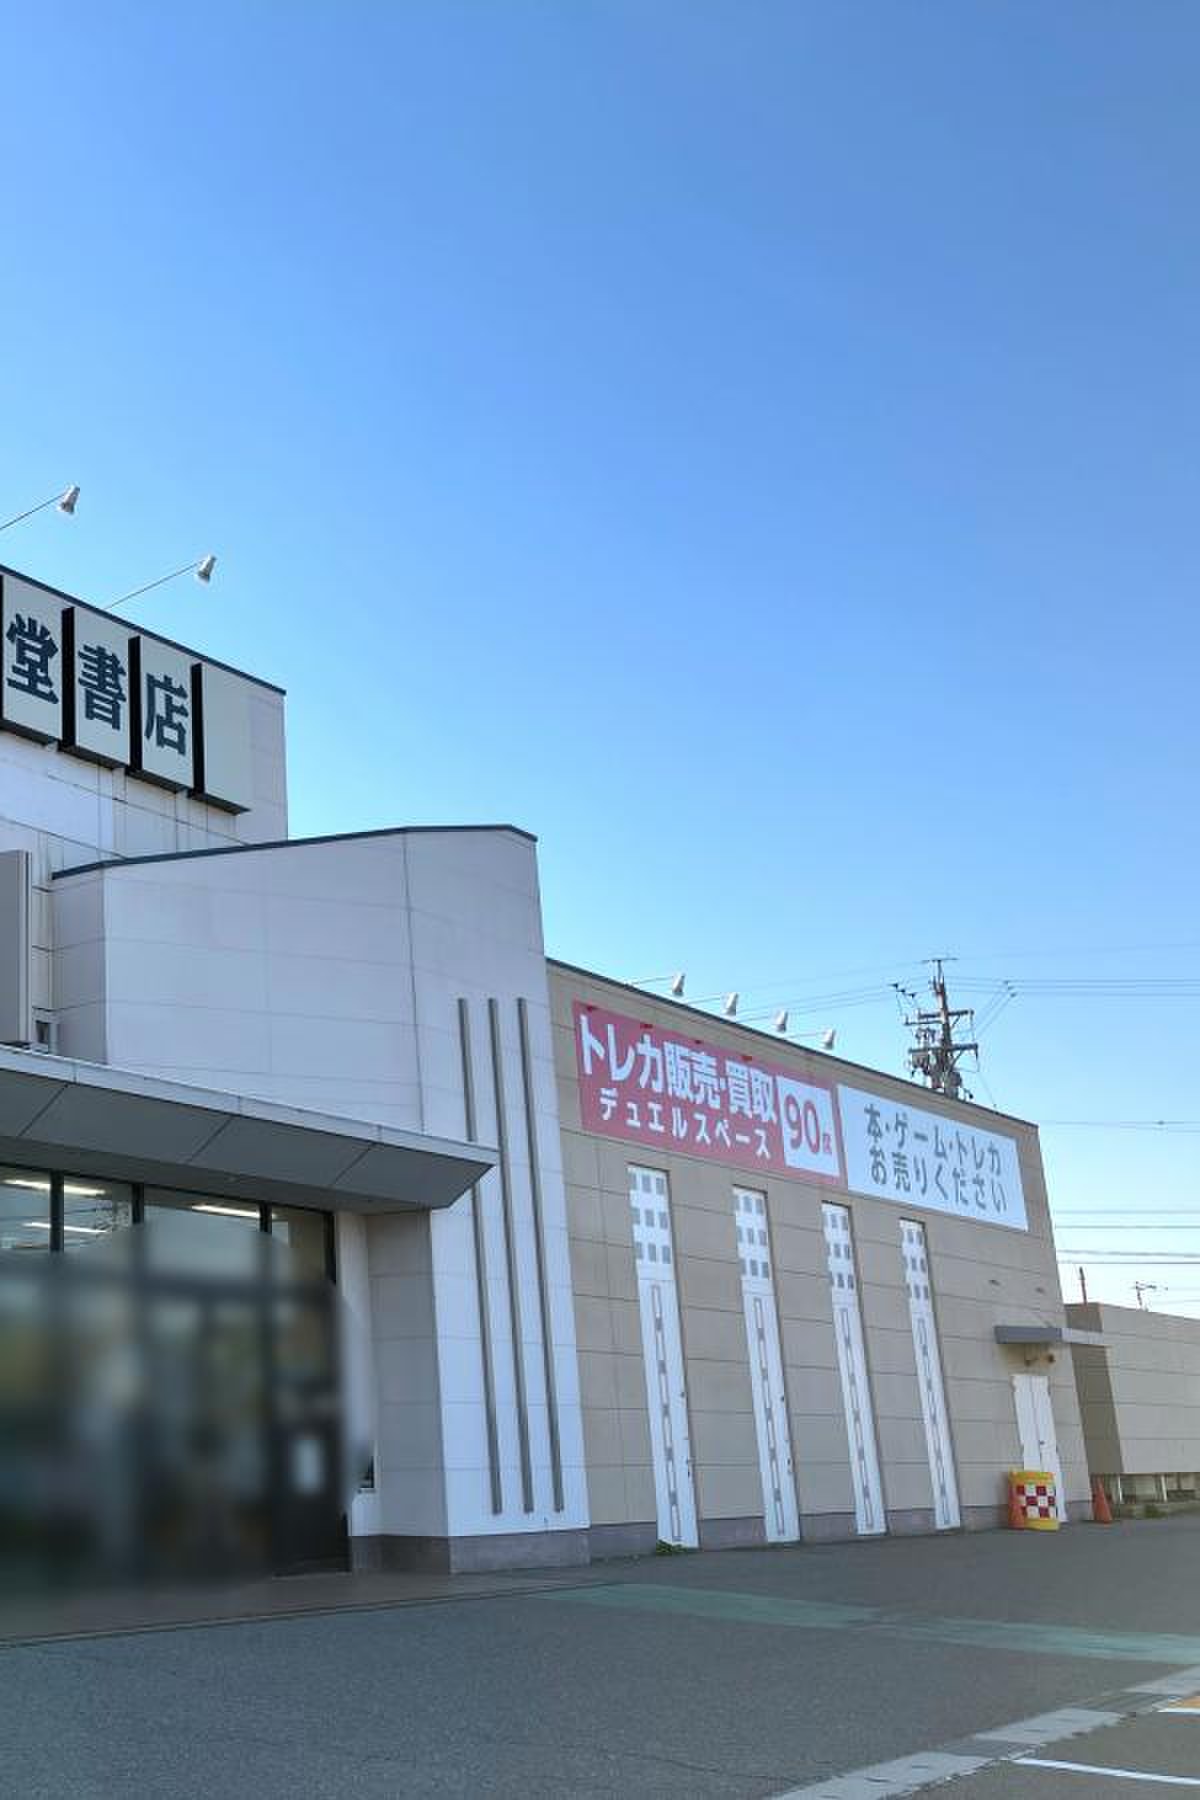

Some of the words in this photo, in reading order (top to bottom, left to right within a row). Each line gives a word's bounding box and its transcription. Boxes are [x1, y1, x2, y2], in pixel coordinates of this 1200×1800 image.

[869, 1145, 1007, 1213] お売りください
